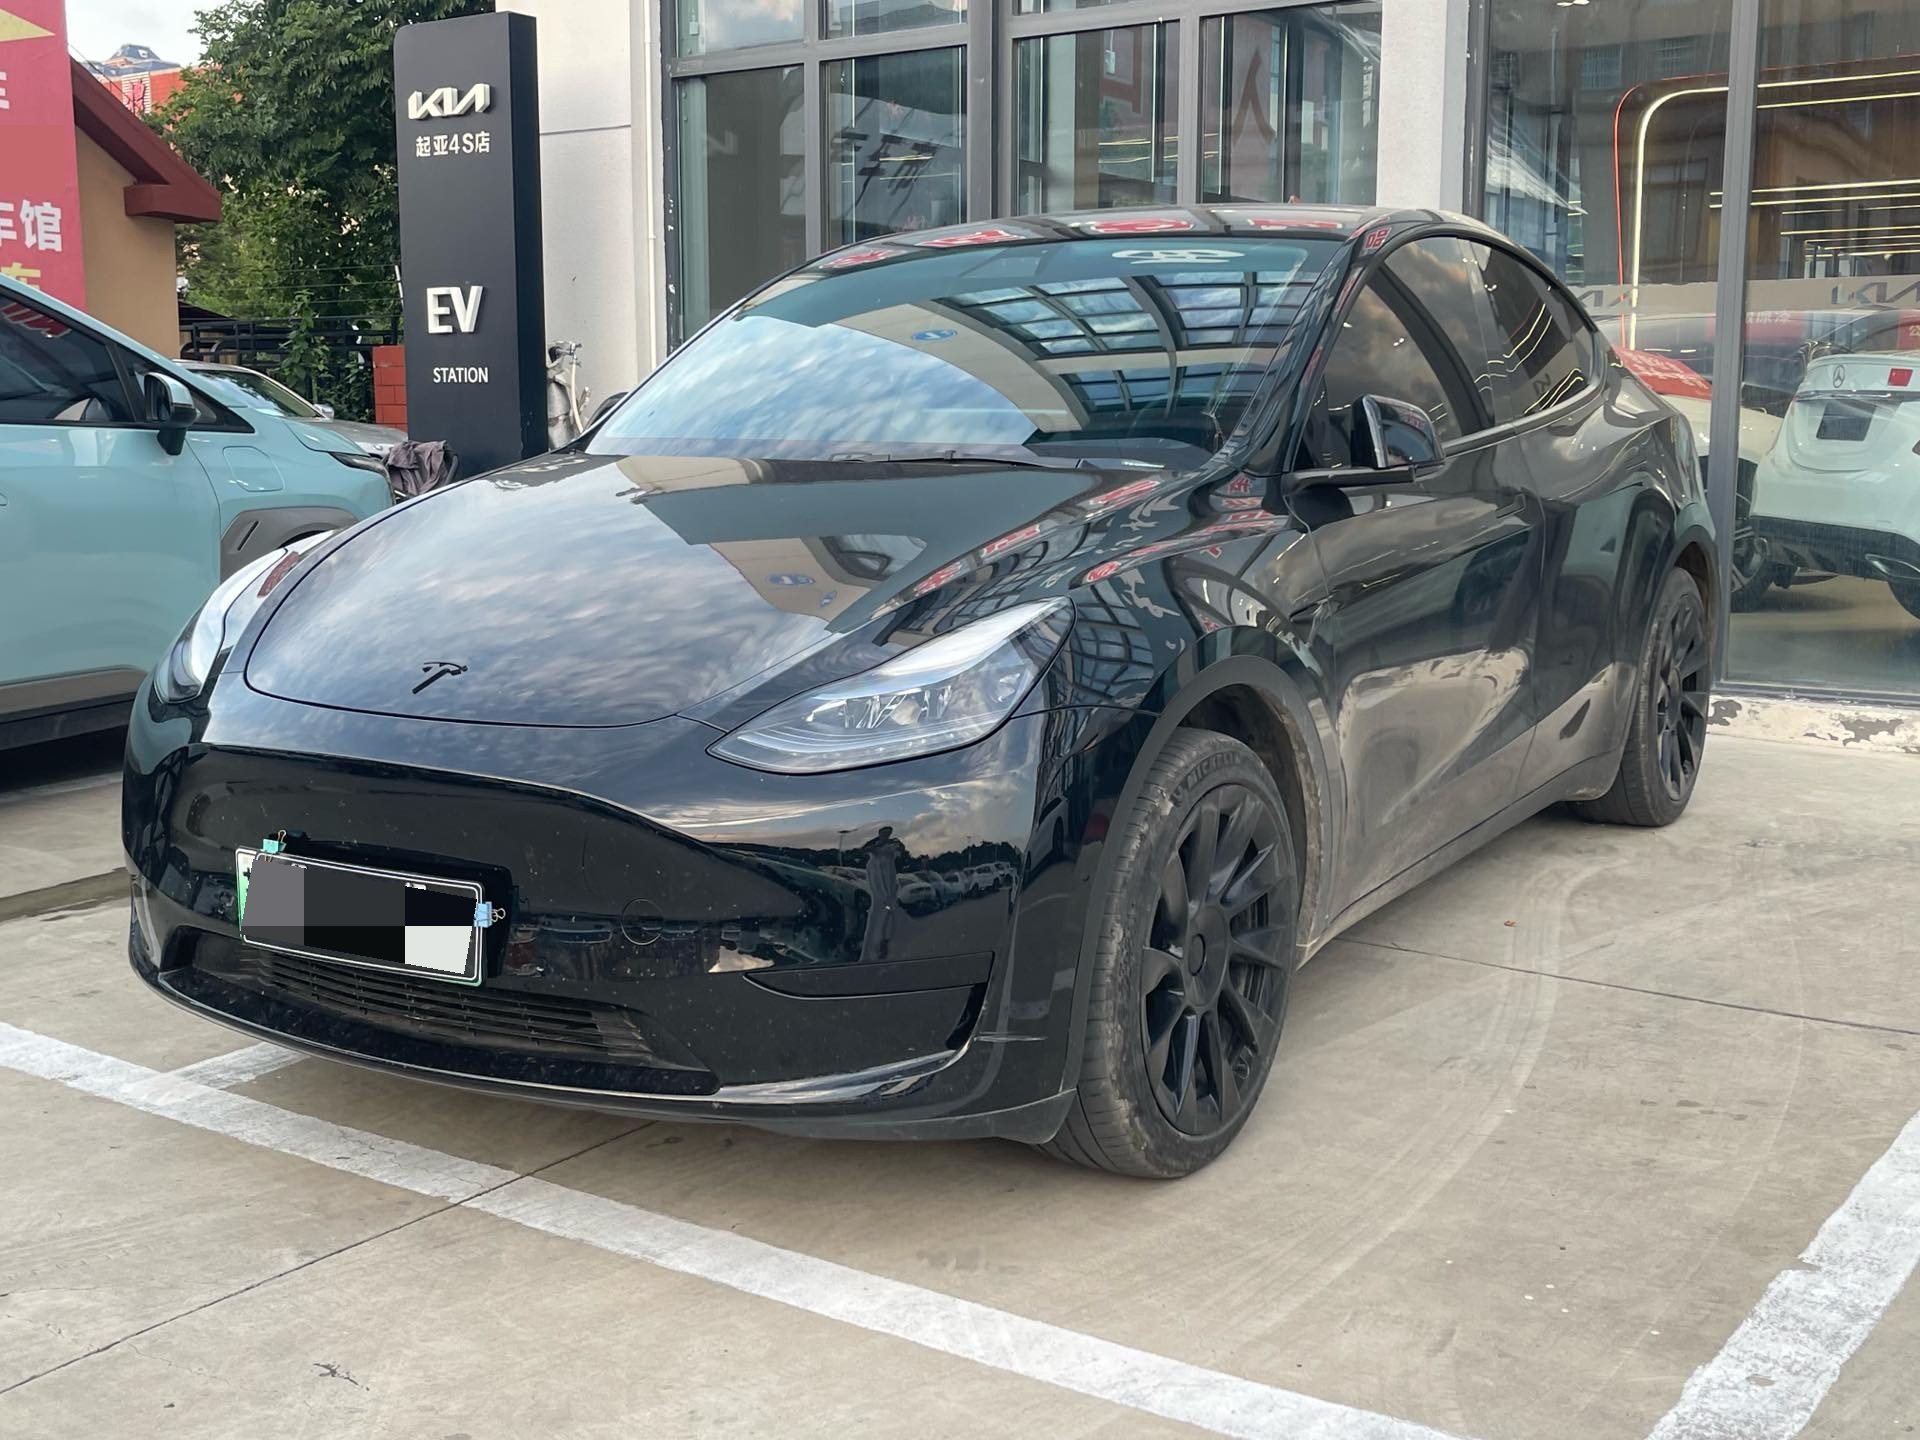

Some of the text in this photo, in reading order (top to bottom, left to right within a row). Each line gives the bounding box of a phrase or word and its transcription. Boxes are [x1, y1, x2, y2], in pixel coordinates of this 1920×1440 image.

[408, 83, 490, 119] KIA
[416, 131, 490, 157] 起亚4S店
[426, 285, 483, 334] EV
[433, 367, 489, 384] STATION
